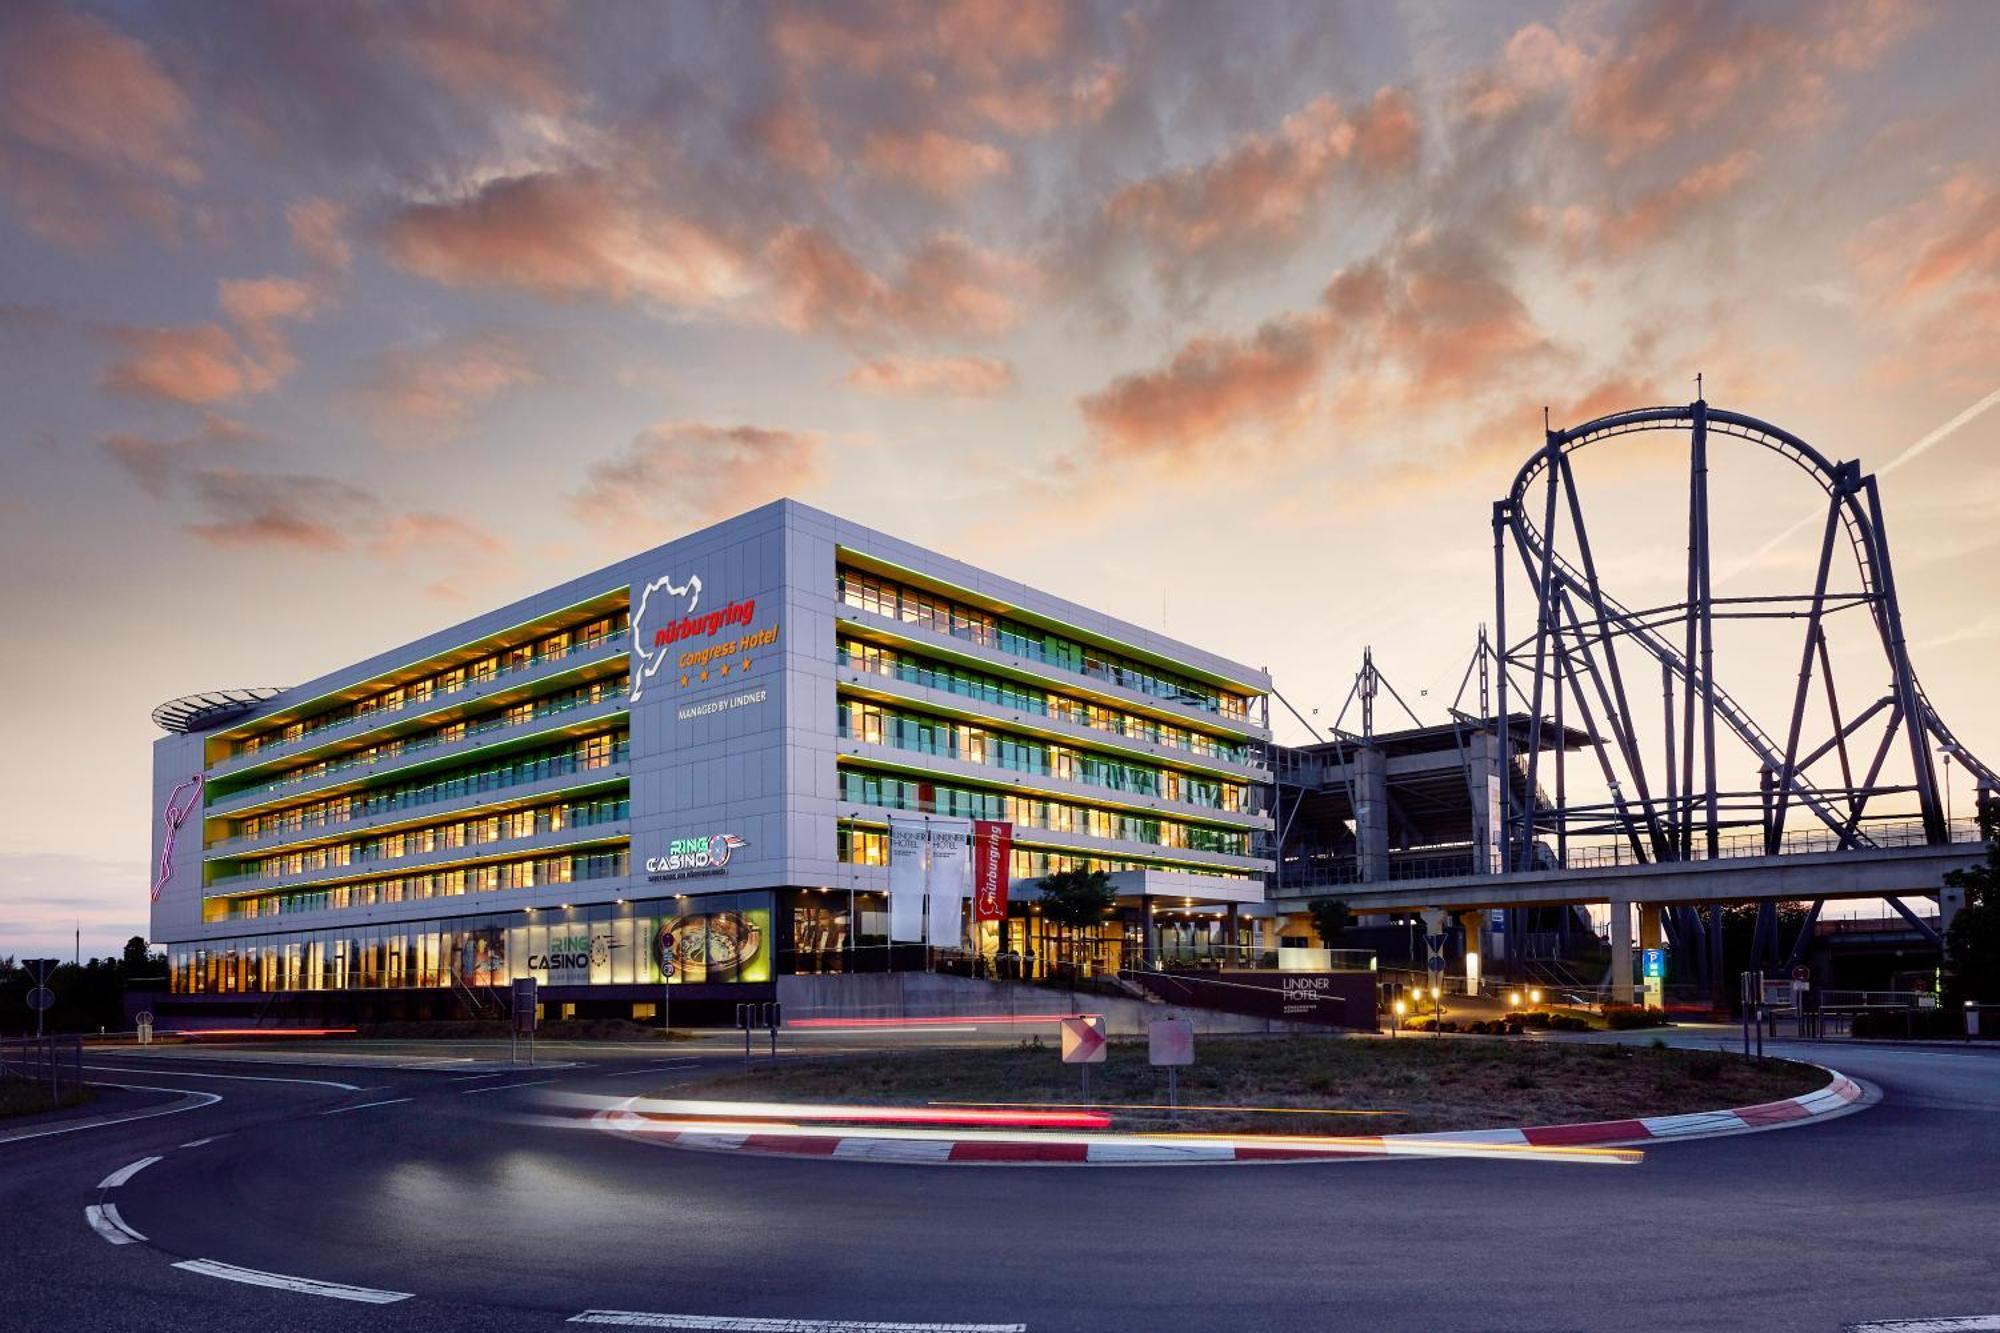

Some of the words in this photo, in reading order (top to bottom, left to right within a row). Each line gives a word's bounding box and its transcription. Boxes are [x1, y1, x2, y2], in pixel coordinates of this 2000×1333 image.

[655, 599, 754, 648] nürburgring
[679, 641, 736, 669] Congress
[739, 624, 779, 651] Hotel
[679, 702, 717, 720] MANAGED
[719, 699, 729, 711] BY
[730, 690, 767, 708] LINDNER
[670, 836, 710, 855] RING
[894, 840, 919, 849] HOTEL
[646, 854, 710, 873] CASINO
[987, 825, 1002, 900] nürburgring
[551, 936, 589, 952] RING
[528, 953, 589, 970] CASINO
[1283, 978, 1330, 990] LINDNER
[1283, 990, 1320, 1001] HOTEL
